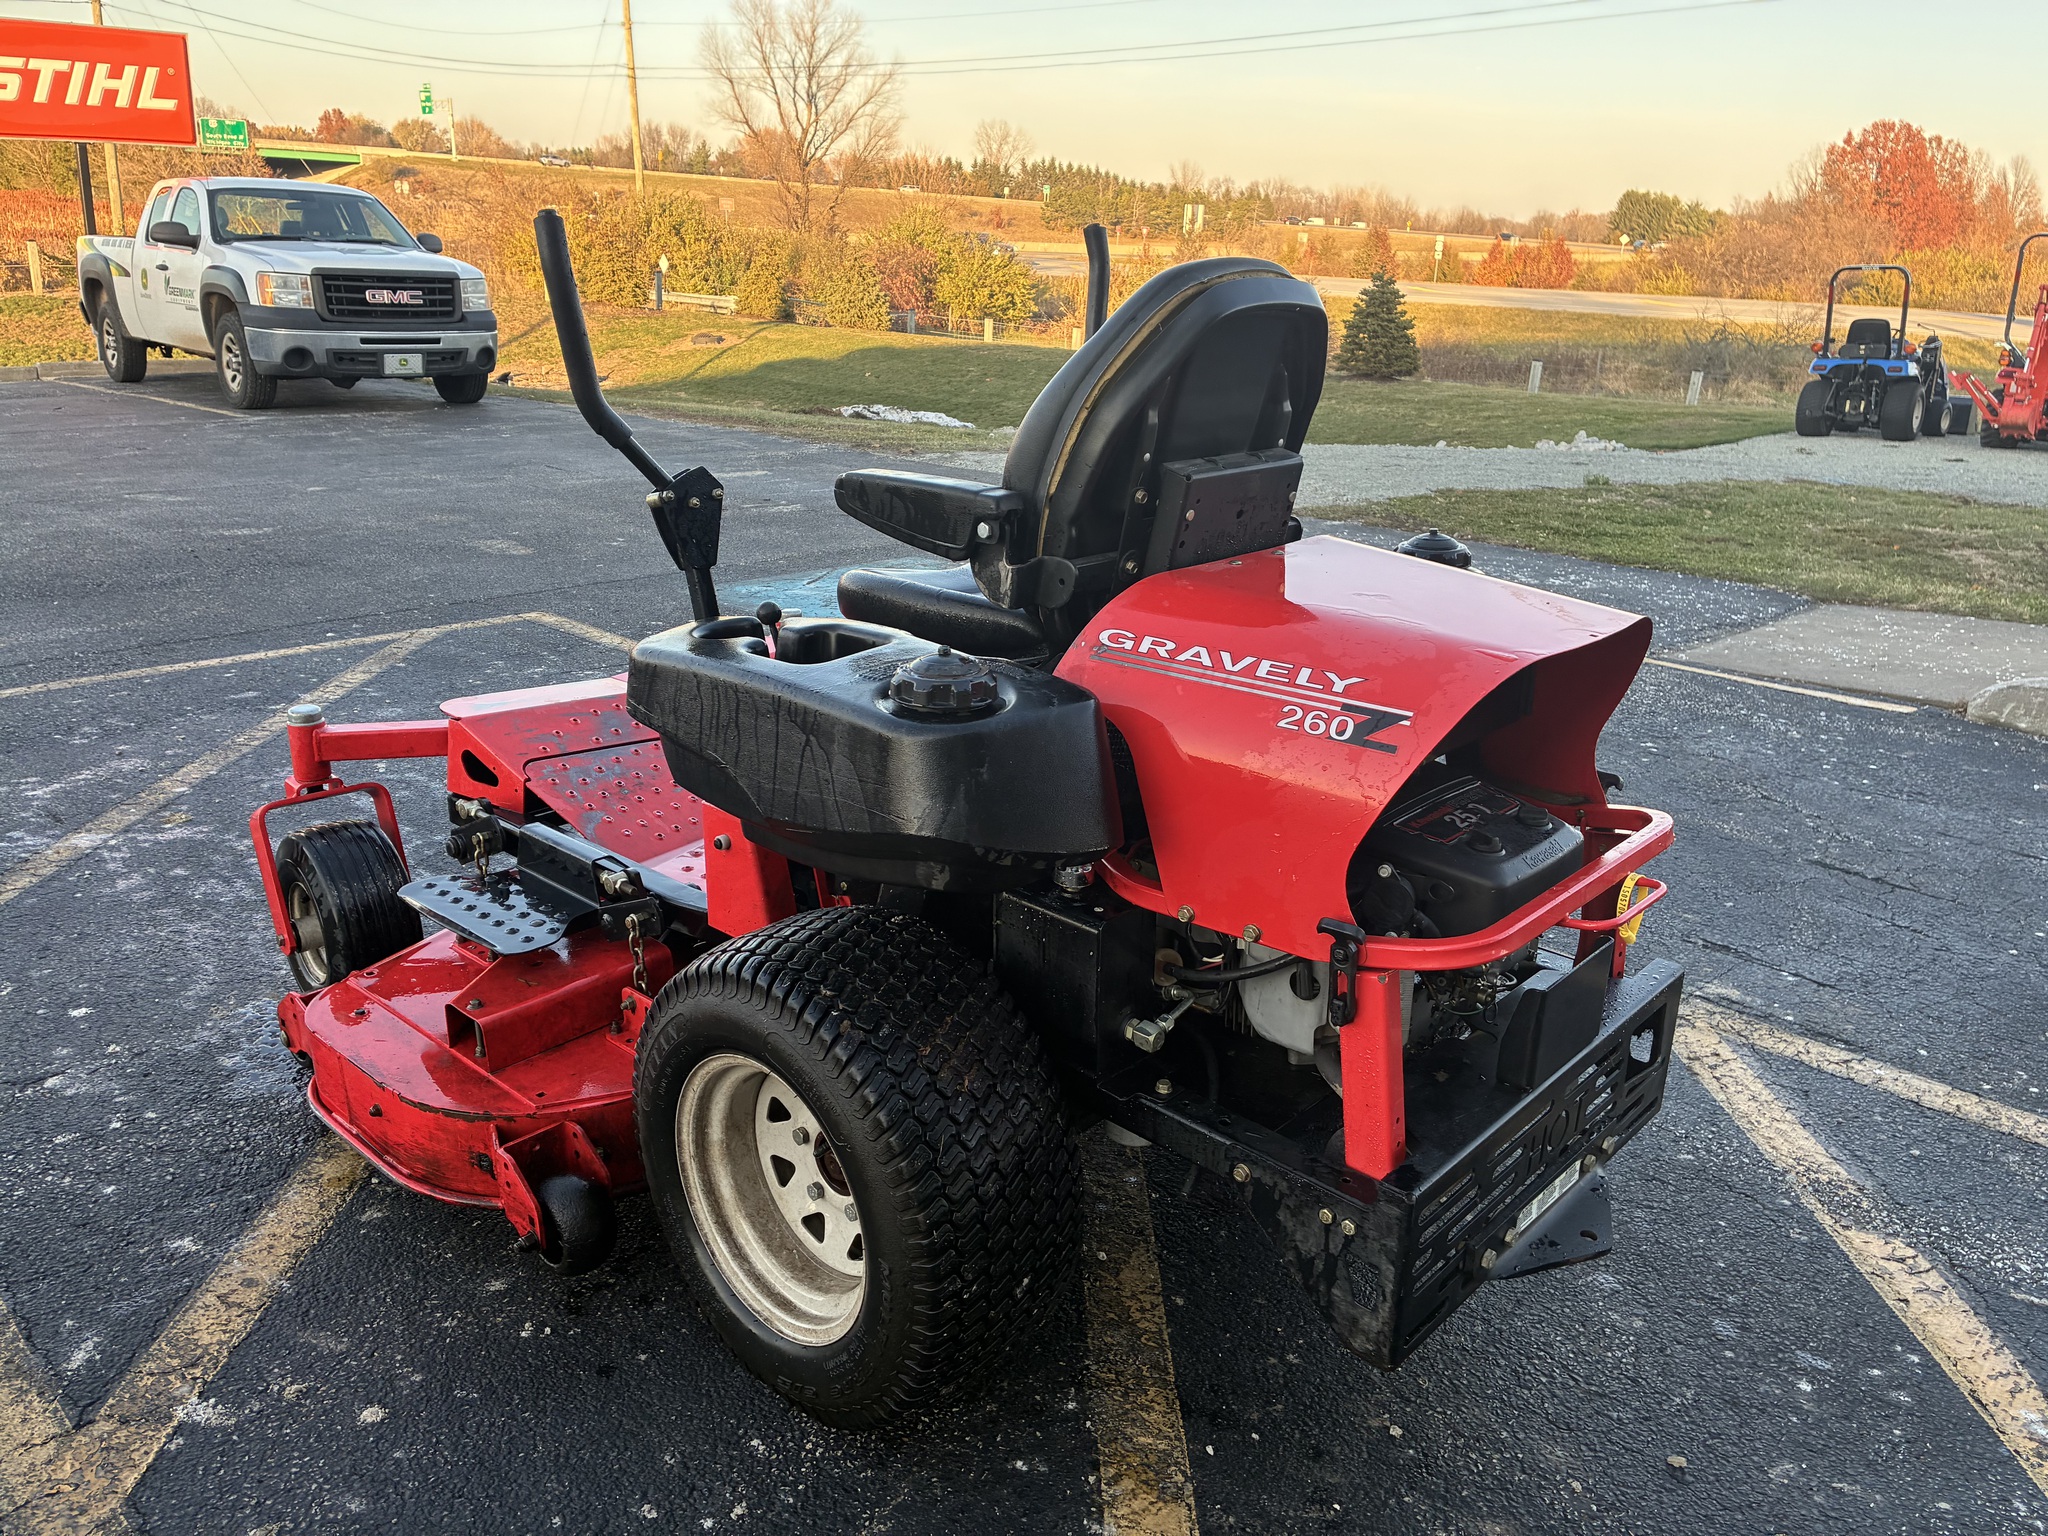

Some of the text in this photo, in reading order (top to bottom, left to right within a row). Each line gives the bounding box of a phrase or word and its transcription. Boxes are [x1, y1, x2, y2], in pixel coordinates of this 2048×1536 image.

[365, 289, 424, 304] GMC
[1097, 628, 1369, 695] GRAVELY
[1521, 838, 1565, 870] Kawasaki
